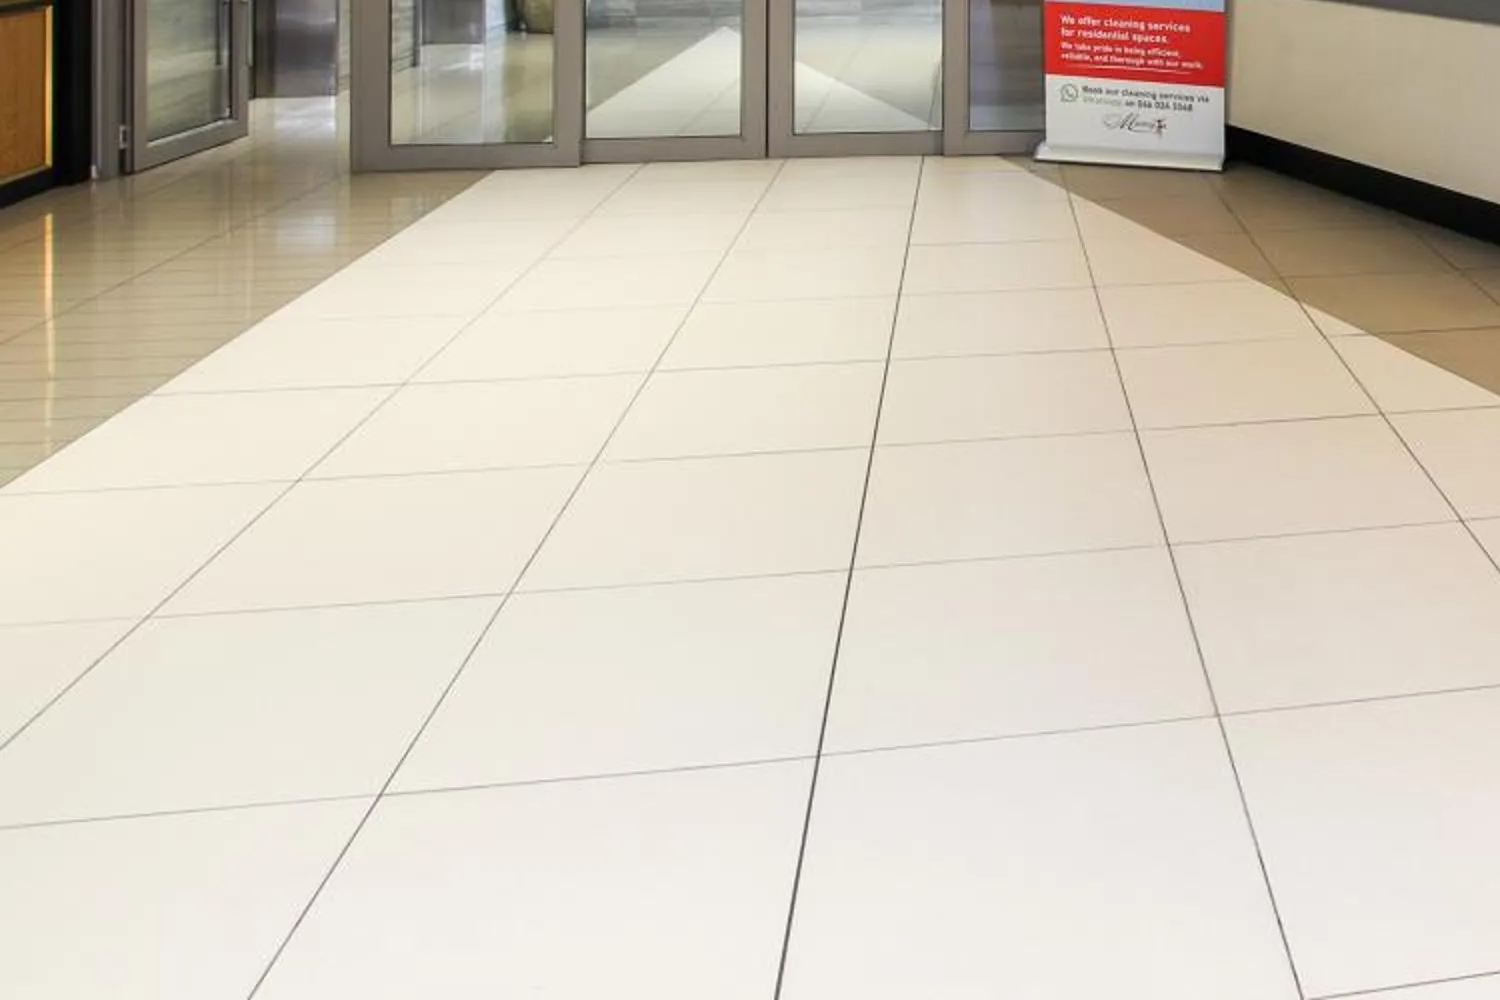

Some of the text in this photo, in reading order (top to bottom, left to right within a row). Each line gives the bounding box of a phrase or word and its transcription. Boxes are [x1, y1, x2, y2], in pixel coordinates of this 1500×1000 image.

[1060, 15, 1191, 33] We offer cleaning services
[1060, 27, 1076, 37] for
[1077, 29, 1130, 41] residential
